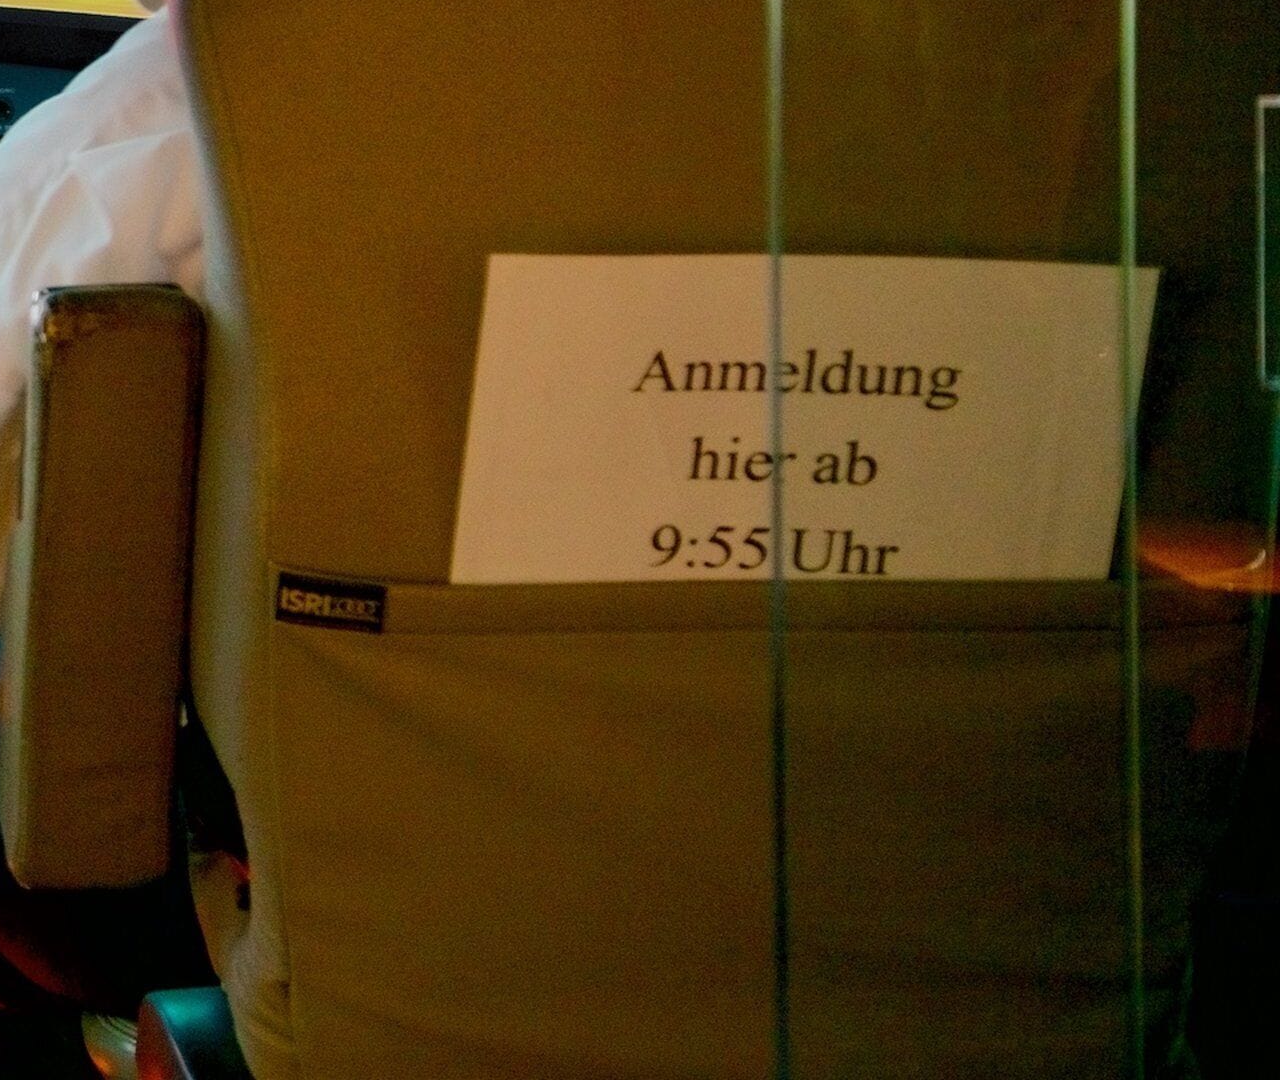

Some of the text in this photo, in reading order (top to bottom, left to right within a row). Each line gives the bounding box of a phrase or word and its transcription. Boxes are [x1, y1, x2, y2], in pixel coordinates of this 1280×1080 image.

[633, 349, 963, 410] Anmeldung
[813, 441, 877, 486] ab
[651, 524, 900, 575] 9:55 Uhr
